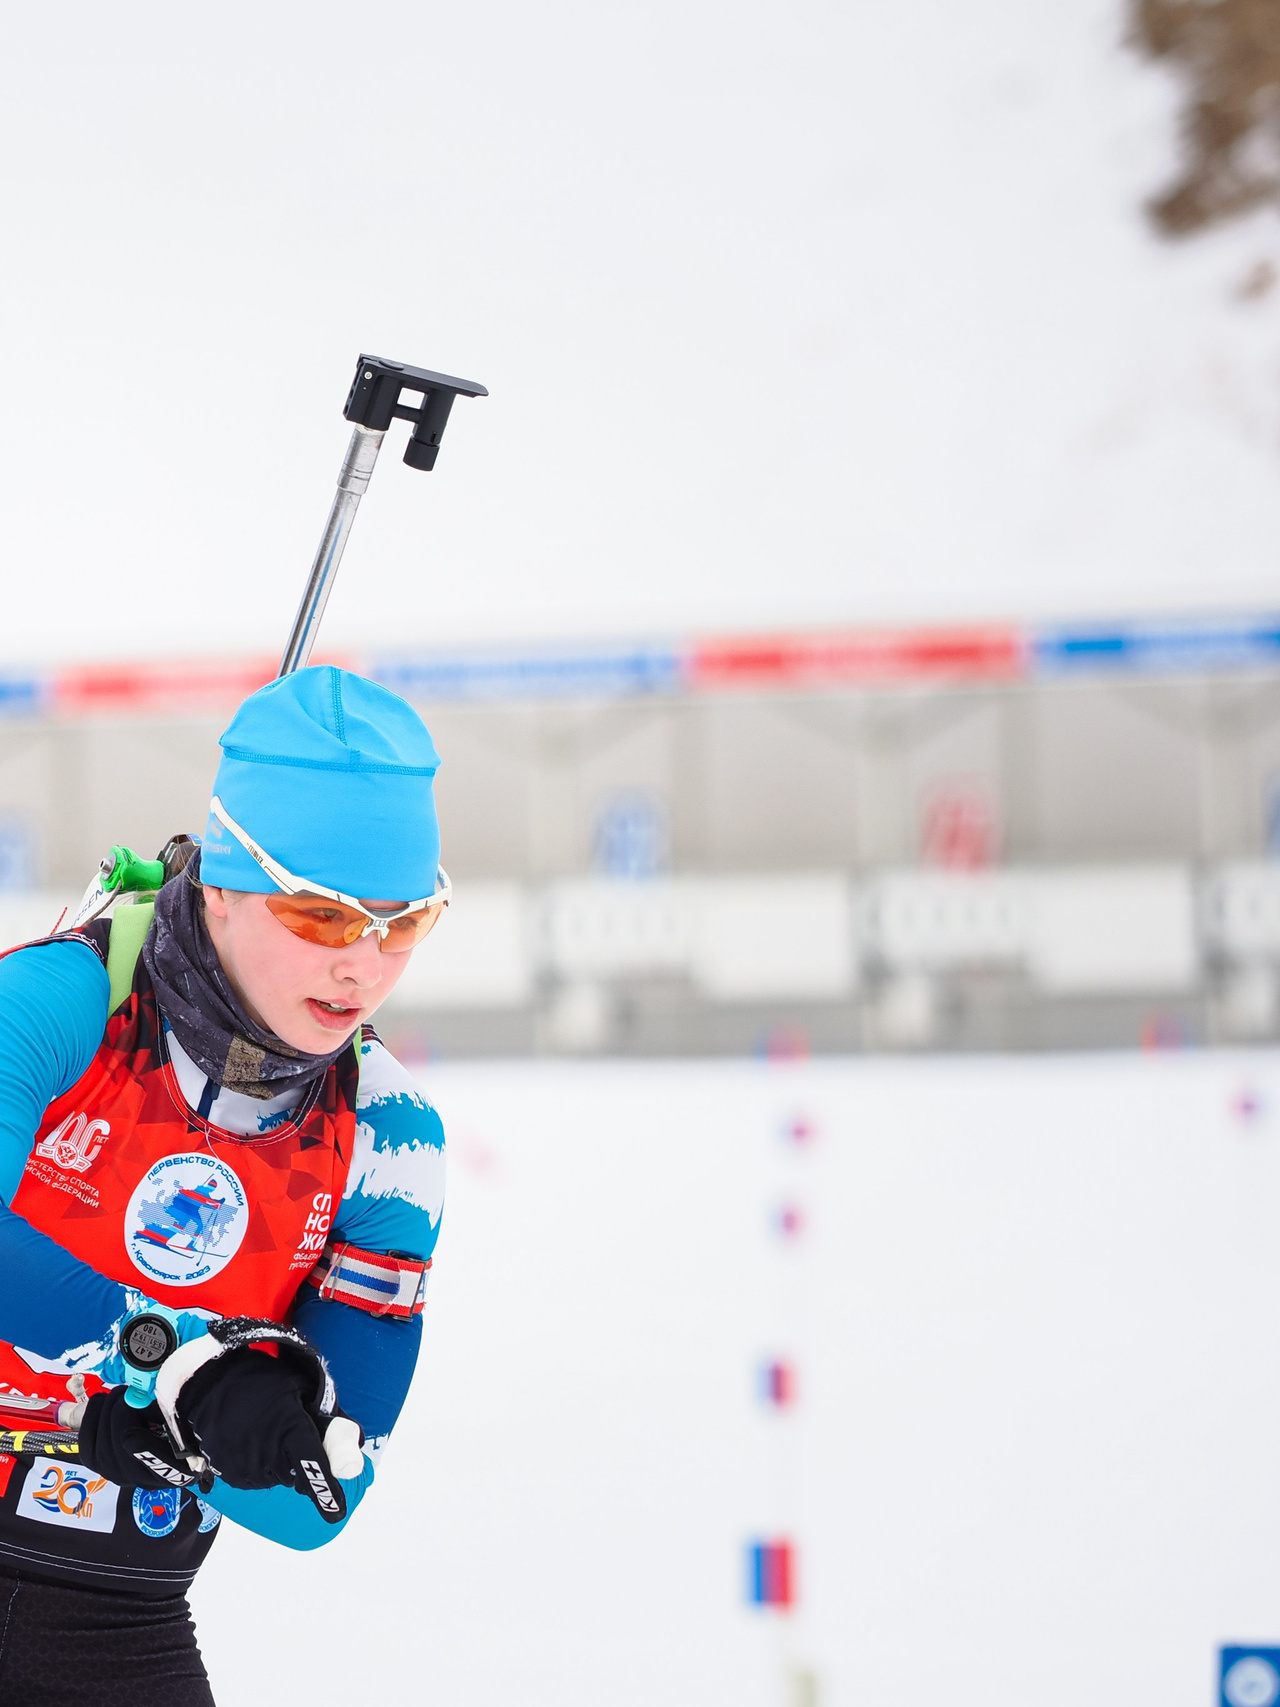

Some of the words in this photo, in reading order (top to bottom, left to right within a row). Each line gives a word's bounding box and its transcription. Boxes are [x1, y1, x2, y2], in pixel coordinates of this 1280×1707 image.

[93, 1135, 109, 1144] ЛЕТ
[69, 1176, 100, 1198] СПОРТА
[147, 1156, 216, 1181] ПЕРВЕНСТВО
[216, 1164, 244, 1206] РОССИИ
[134, 1249, 182, 1280] Красноярск
[185, 1265, 211, 1280] 2023
